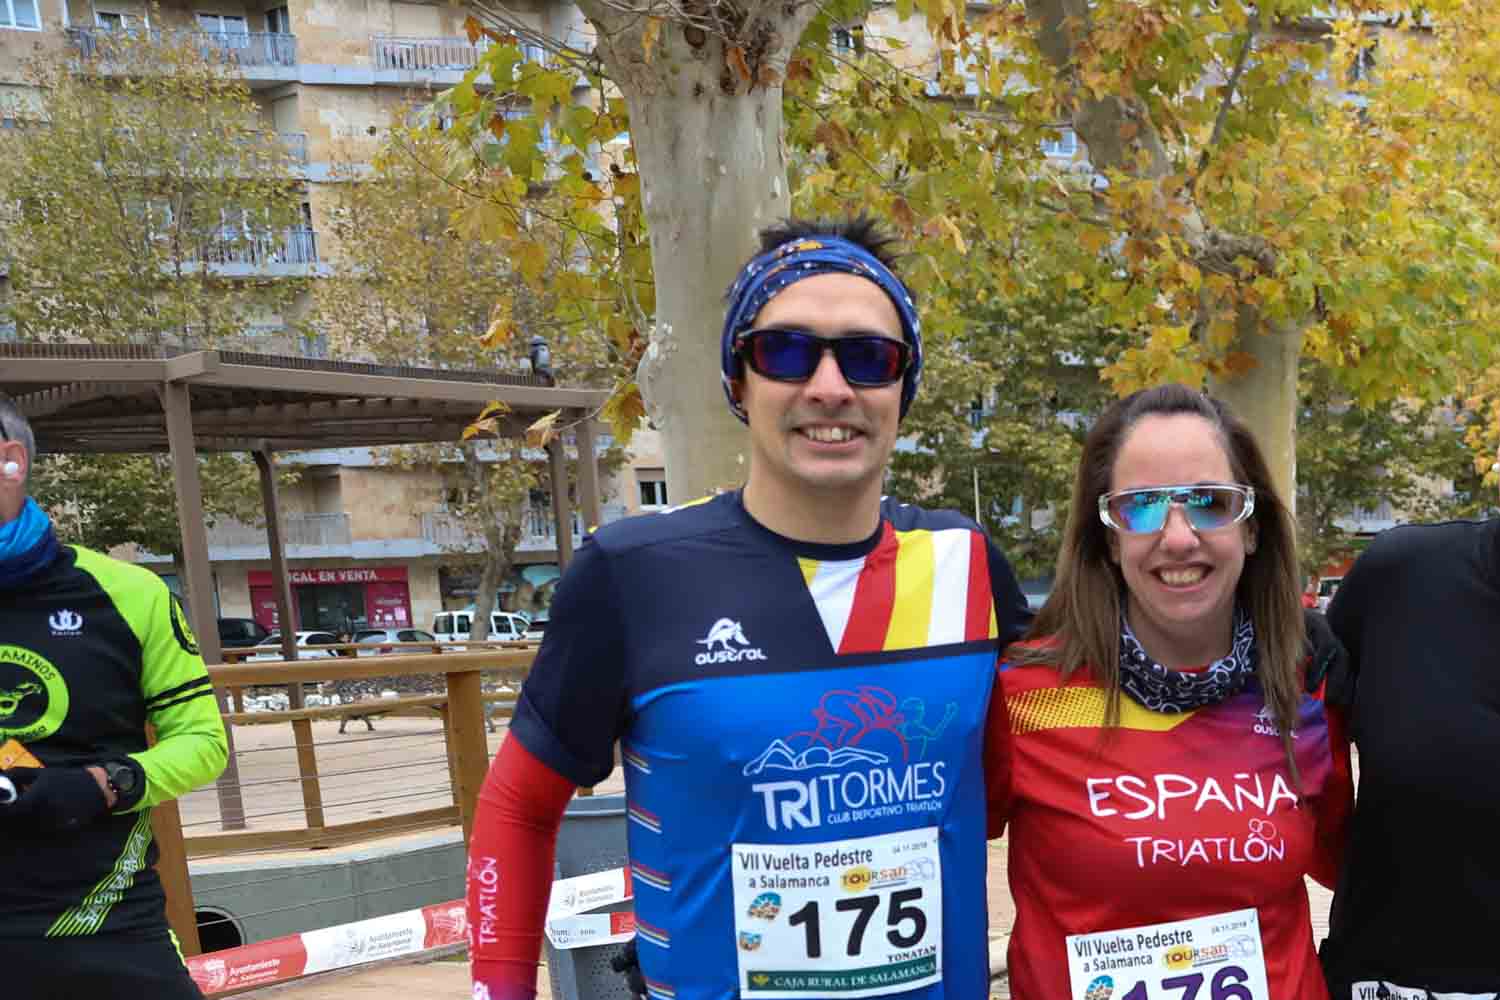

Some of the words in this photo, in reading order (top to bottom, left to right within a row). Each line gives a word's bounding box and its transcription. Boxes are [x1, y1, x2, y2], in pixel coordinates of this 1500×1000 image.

[288, 570, 317, 583] CAL
[319, 571, 336, 582] EN
[339, 569, 378, 582] VENTA
[1086, 773, 1299, 820] ESPAÑA
[827, 812, 850, 824] CLUB
[852, 806, 903, 822] DEPORTIVO
[739, 852, 759, 870] VII
[763, 853, 810, 871] Vuelta
[815, 849, 873, 868] Pedestre
[749, 878, 756, 888] a
[760, 875, 830, 889] Salamanca
[789, 887, 928, 959] 175
[1074, 940, 1091, 957] VII
[1093, 937, 1134, 955] Vuelta
[1137, 929, 1193, 949] Pedestre
[1083, 962, 1090, 972] a
[1093, 955, 1153, 972] Salamanca
[774, 976, 804, 988] CAJA
[807, 975, 849, 988] RURAL
[851, 974, 867, 985] DE
[869, 961, 936, 984] SALAMANCA
[1358, 987, 1375, 1000] VII
